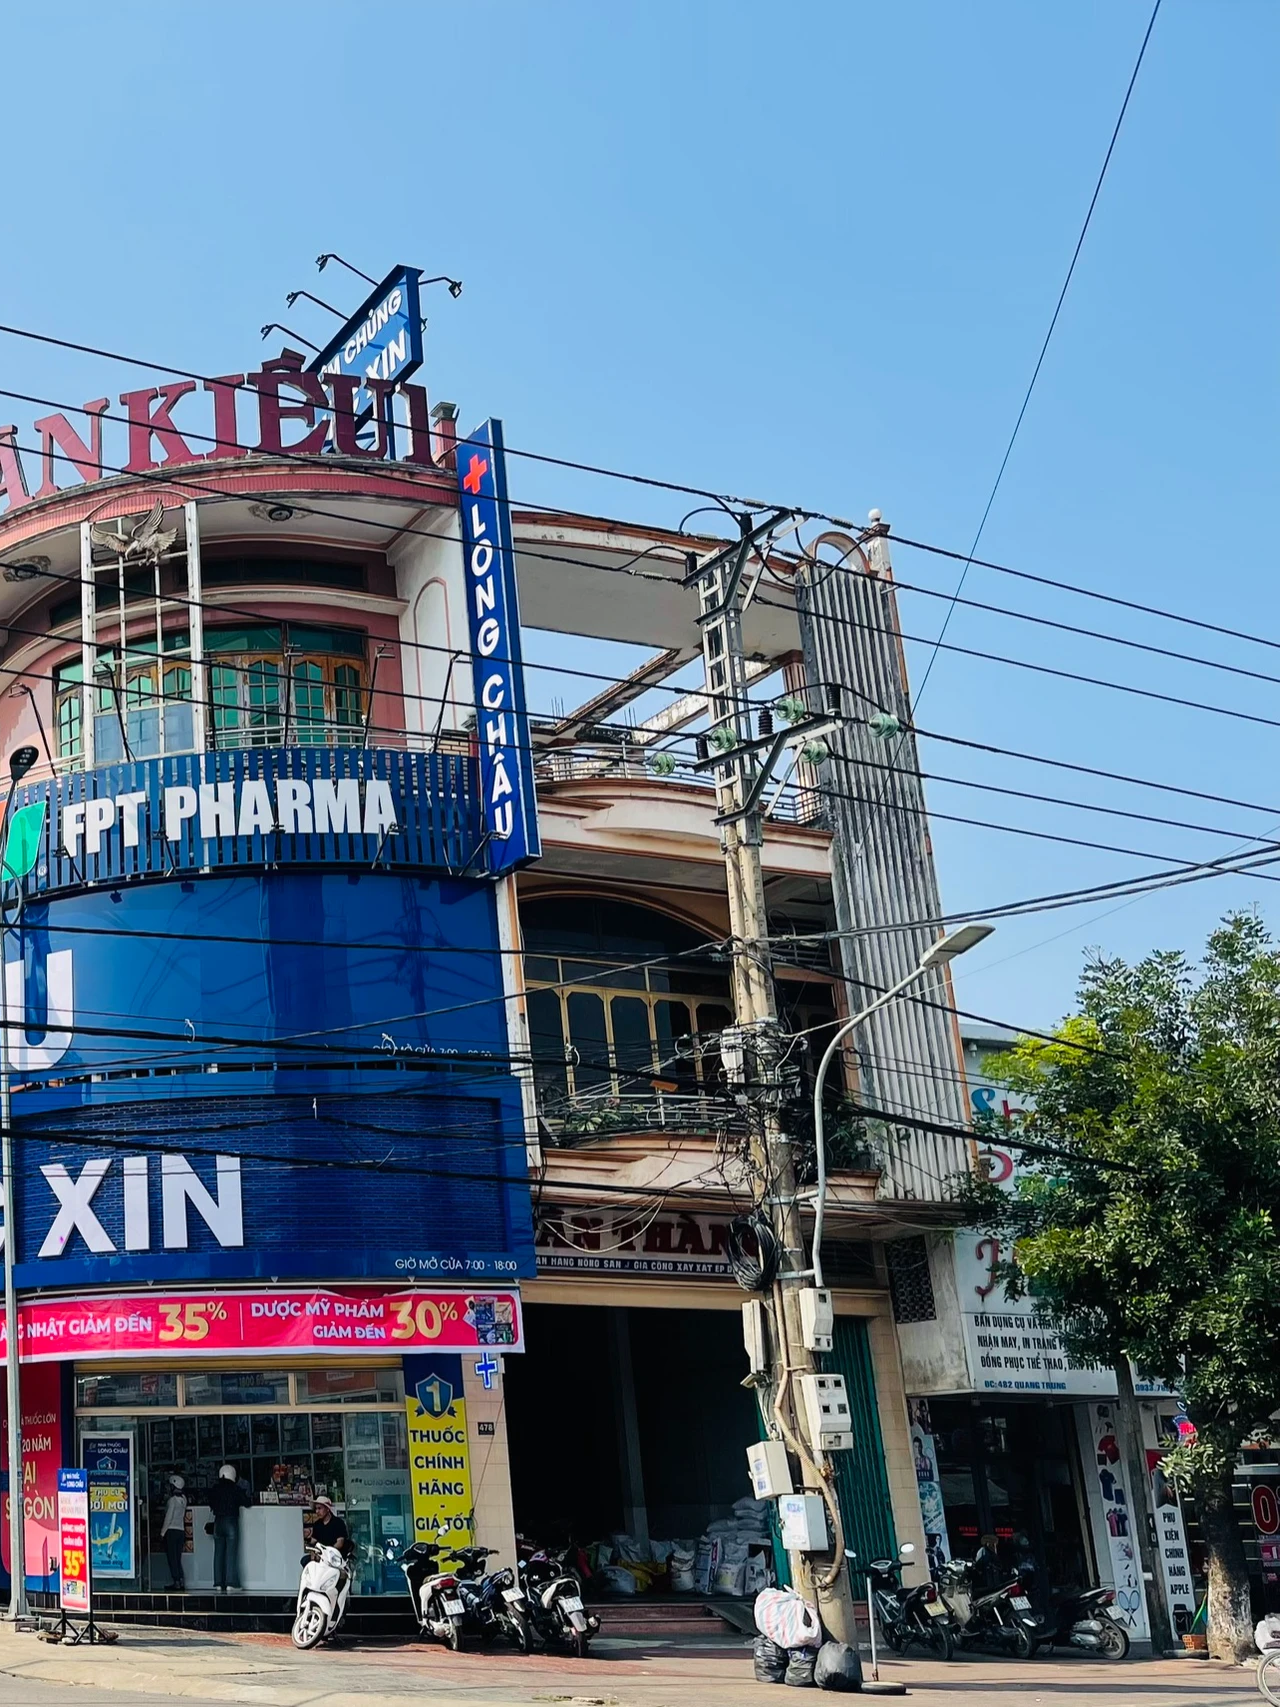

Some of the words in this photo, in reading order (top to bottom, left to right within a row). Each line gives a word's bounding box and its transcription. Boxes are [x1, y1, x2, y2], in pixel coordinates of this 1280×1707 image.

[470, 503, 500, 657] LONG
[481, 673, 513, 840] CHÂU
[63, 790, 146, 859] FPT
[164, 778, 399, 841] PHARMA
[37, 1154, 245, 1257] XIN
[395, 1256, 417, 1269] GIỜ
[419, 1256, 439, 1270] MỞ
[440, 1256, 464, 1270] CỬA
[465, 1260, 485, 1270] 7:00
[494, 1260, 517, 1271] 18:00
[27, 1317, 65, 1341] NHẬT
[68, 1313, 111, 1335] GIẢM
[114, 1310, 152, 1333] ĐẾN
[158, 1301, 227, 1342] 35%
[251, 1301, 302, 1320] DƯỢC
[305, 1298, 332, 1316] MỸ
[334, 1298, 384, 1318] PHẨM
[390, 1300, 458, 1339] 30%
[993, 1316, 1014, 1331] DỤNG
[1015, 1317, 1026, 1332] CỤ
[313, 1323, 352, 1339] GIẢM
[354, 1323, 386, 1339] ĐẾN
[977, 1333, 999, 1350] NHẬN
[1022, 1338, 1031, 1349] IN
[1032, 1338, 1057, 1350] TRANG
[1004, 1356, 1025, 1373] PHỤC
[1014, 1381, 1040, 1389] QUANG
[1041, 1381, 1066, 1390] TRUNG
[426, 1381, 442, 1412] 1
[410, 1426, 465, 1444] THUỐC
[479, 1424, 493, 1432] 478
[32, 1434, 52, 1452] NĂM
[414, 1456, 464, 1469] CHÍNH
[22, 1461, 36, 1492] ẠI
[418, 1478, 464, 1496] HÃNG
[23, 1489, 55, 1520] GÒN
[416, 1515, 440, 1531] GIÁ
[444, 1513, 472, 1531] TỐT
[1170, 1584, 1190, 1595] APPLE
